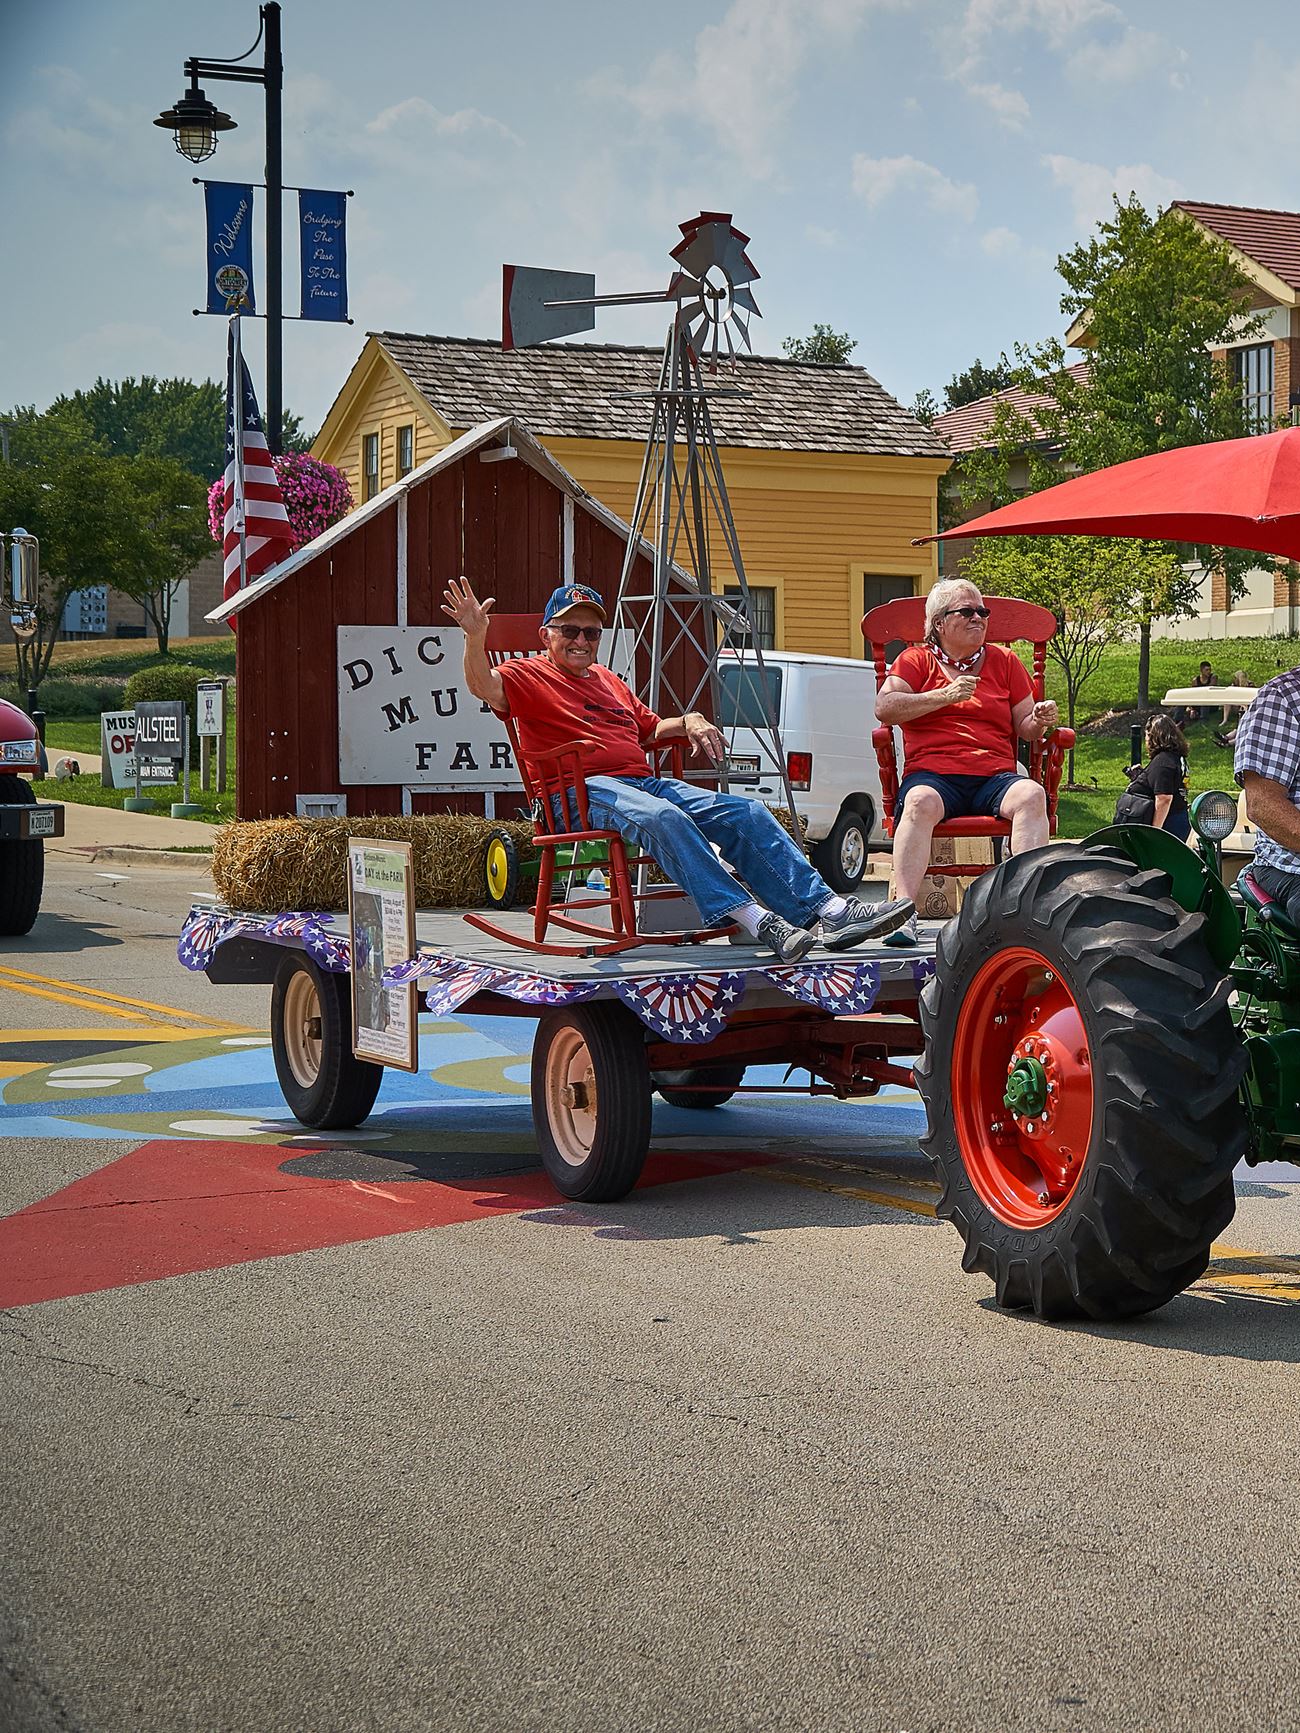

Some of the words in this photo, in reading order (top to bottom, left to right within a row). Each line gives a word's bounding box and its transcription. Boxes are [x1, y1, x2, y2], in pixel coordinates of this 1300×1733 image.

[303, 212, 343, 229] Bridging
[214, 200, 248, 257] Welcome
[313, 231, 334, 243] The
[313, 249, 334, 261] Past
[307, 266, 320, 279] To
[320, 267, 341, 280] The
[310, 285, 339, 299] Future
[343, 635, 445, 690] DIC
[380, 687, 458, 732] MU
[106, 716, 135, 731] MUS
[136, 716, 180, 742] ALLSTEEL
[415, 742, 514, 770] FAR
[124, 769, 137, 777] SA
[151, 766, 174, 777] ENTRANCE
